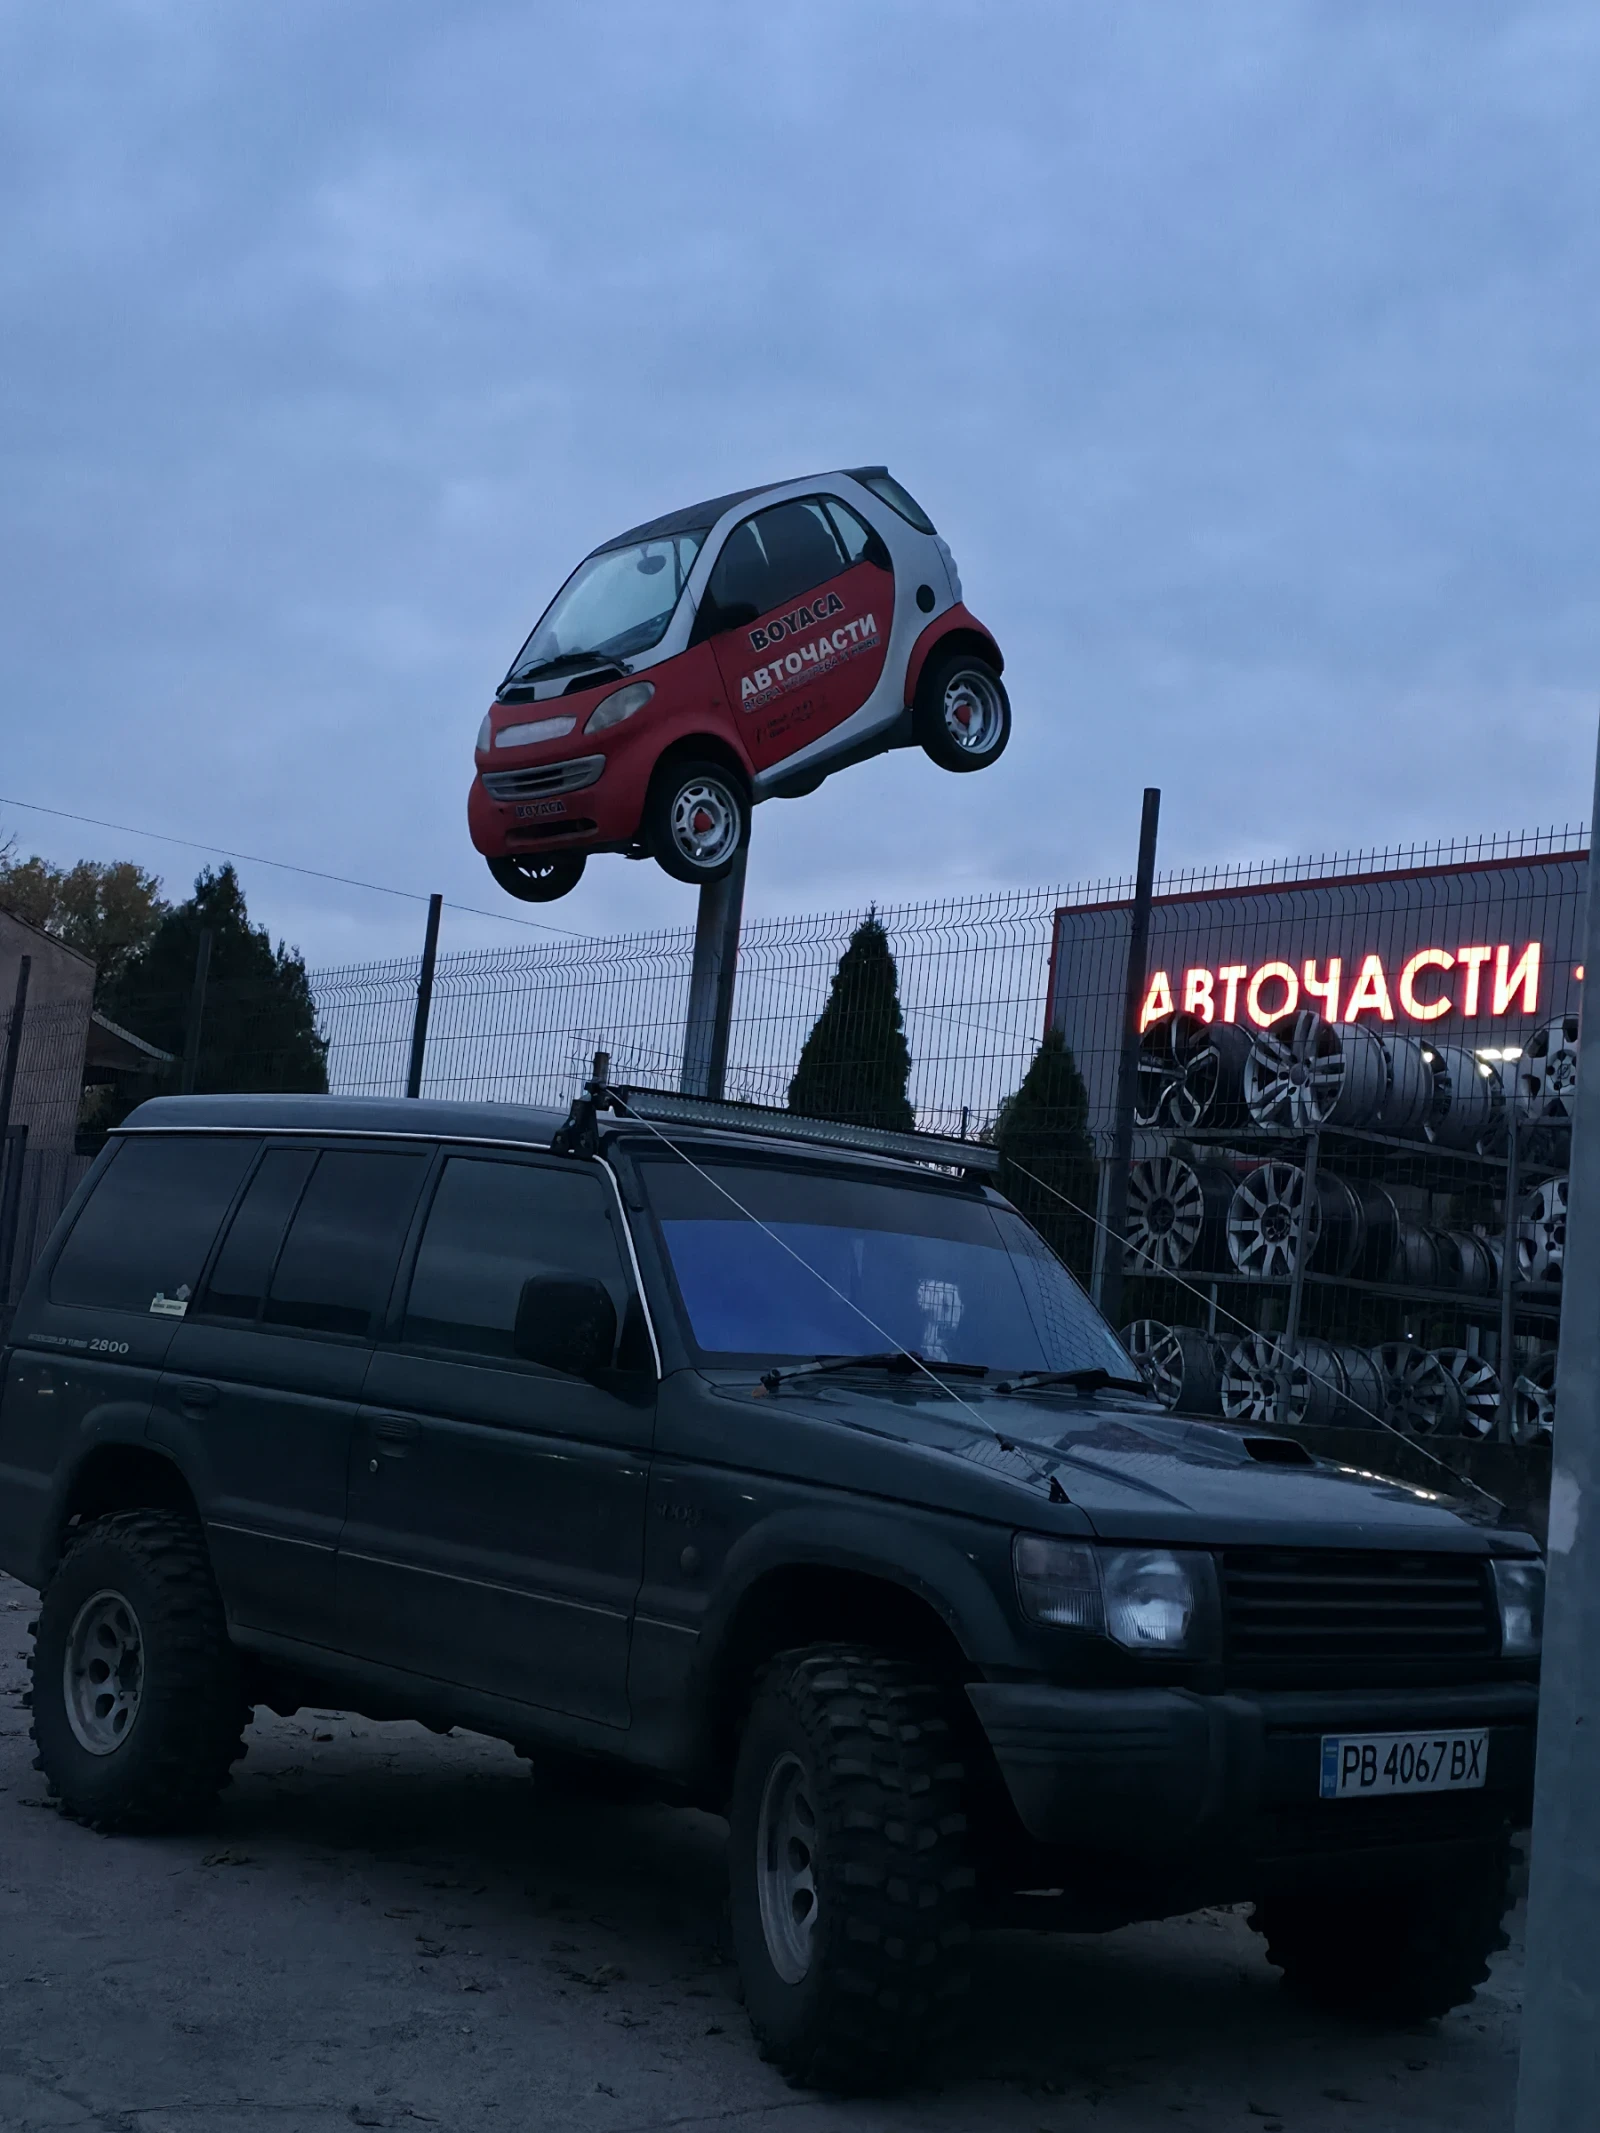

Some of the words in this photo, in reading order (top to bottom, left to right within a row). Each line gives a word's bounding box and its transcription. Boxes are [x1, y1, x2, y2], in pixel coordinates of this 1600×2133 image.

[749, 591, 845, 652] BOYACA
[741, 613, 877, 700] АВТОЧАСТИ
[1140, 942, 1541, 1034] АВТОЧАСТИ
[89, 1338, 130, 1354] 2800
[1341, 1744, 1377, 1788] PB
[1383, 1741, 1447, 1785] 4067
[1450, 1739, 1483, 1780] BX
